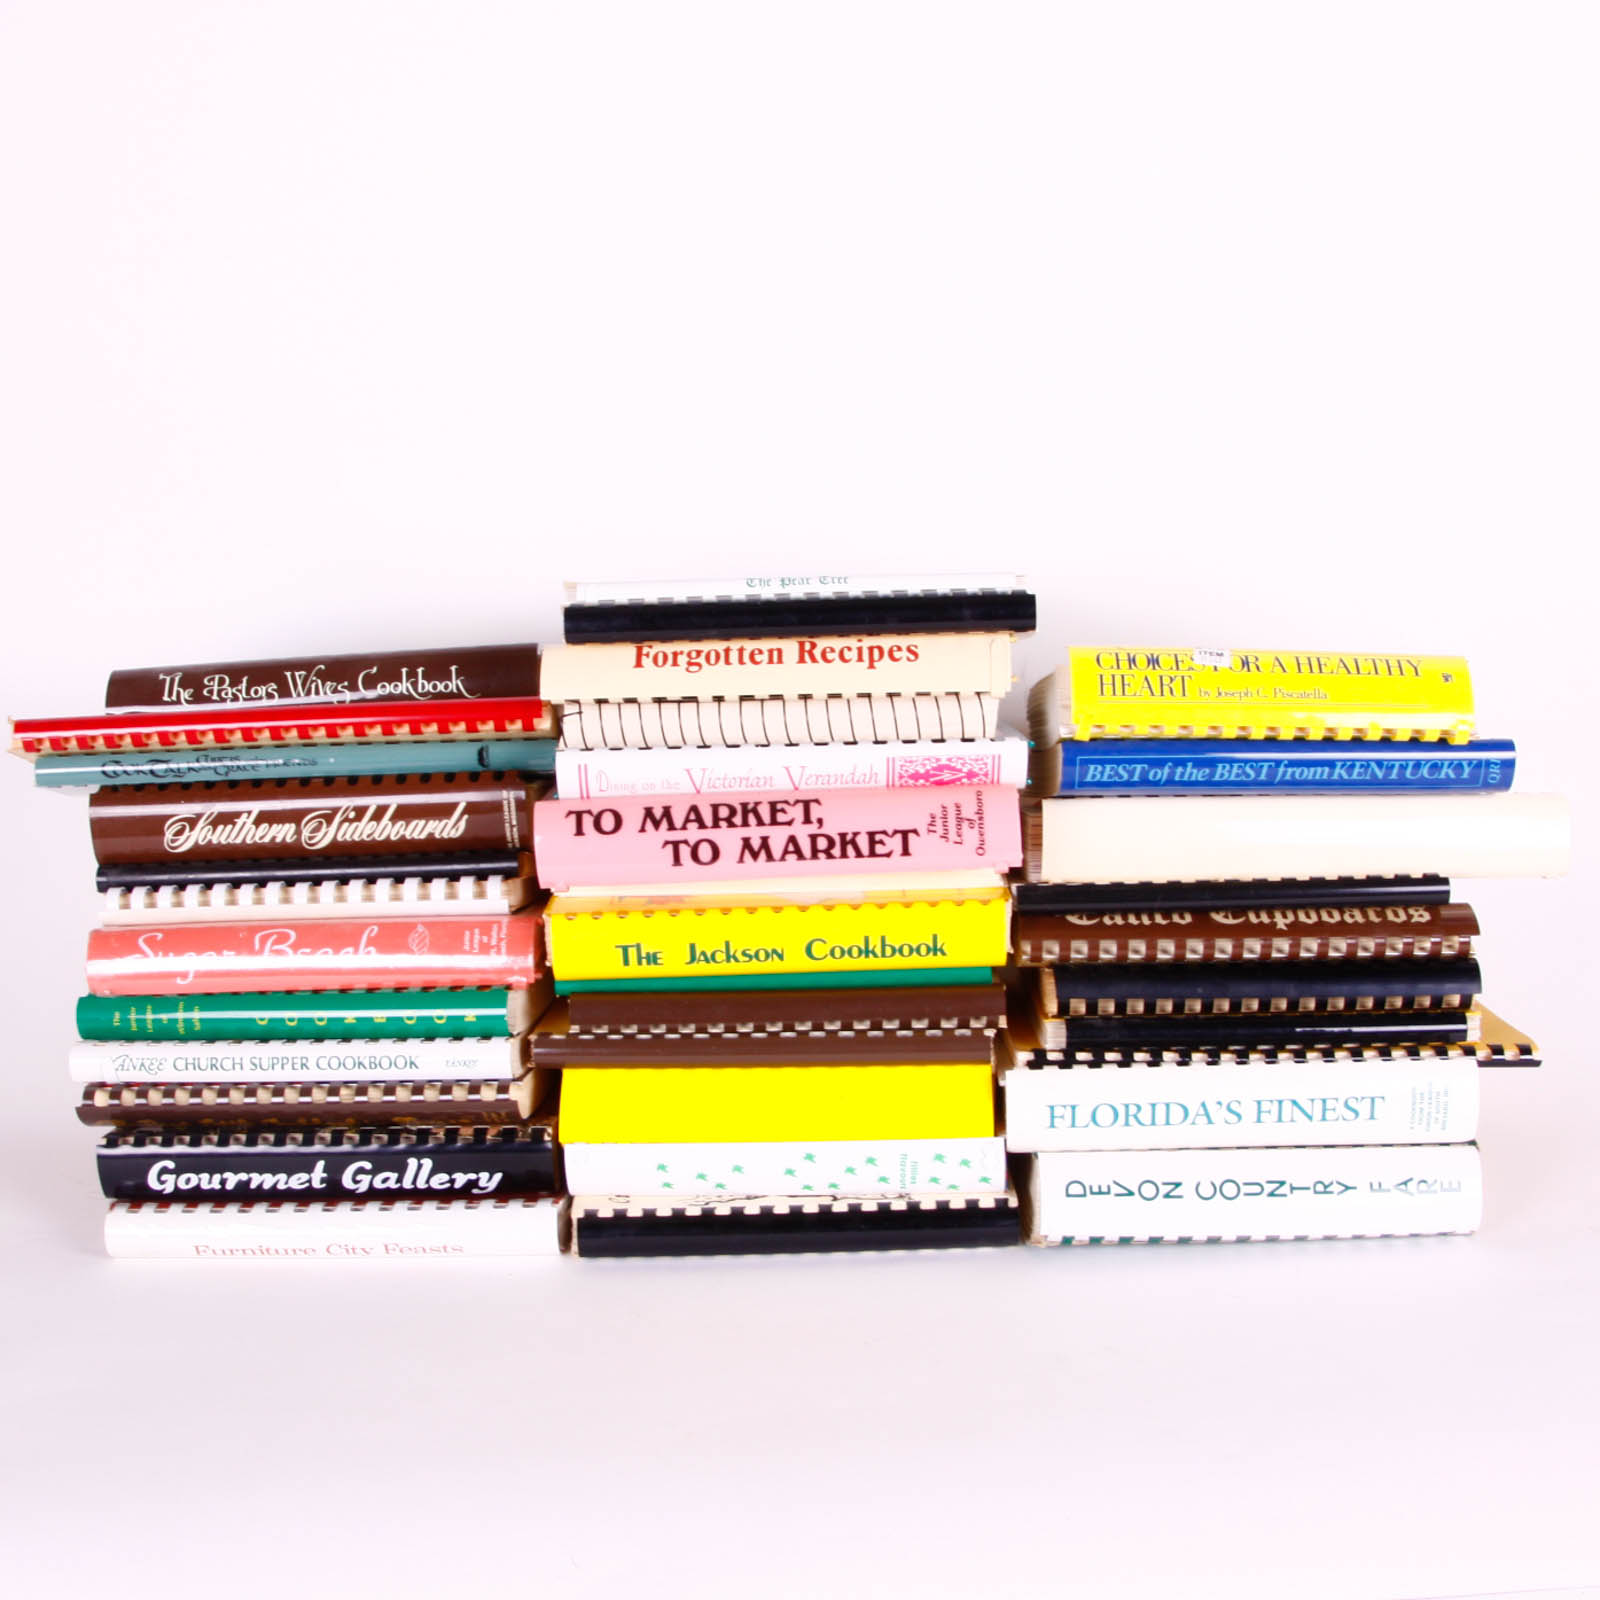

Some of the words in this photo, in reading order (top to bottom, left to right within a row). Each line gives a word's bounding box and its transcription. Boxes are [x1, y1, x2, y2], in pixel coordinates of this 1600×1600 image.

[634, 642, 784, 673] Forgotten
[796, 638, 919, 669] Recipes
[1271, 656, 1289, 673] A
[1296, 656, 1422, 678] HEALTHY
[159, 672, 195, 705] The
[202, 672, 280, 706] Pastors
[285, 664, 349, 705] Wives
[358, 663, 481, 699] Cookbook
[1096, 673, 1193, 698] HEART
[1199, 687, 1211, 698] by
[1214, 686, 1254, 701] Joseph
[1273, 687, 1328, 700] Piscatella
[596, 770, 640, 793] Dining
[642, 780, 656, 792] on
[660, 778, 681, 791] the
[684, 767, 775, 794] Victorian
[784, 764, 880, 792] Verandah
[1084, 764, 1148, 783] BEST
[1148, 762, 1173, 784] of
[1174, 763, 1210, 782] the
[1213, 762, 1275, 781] BEST
[1275, 760, 1336, 785] from
[1333, 759, 1476, 781] KENTUCKY
[164, 804, 297, 854] Southern
[300, 801, 468, 851] Sideboards
[565, 807, 623, 837] TO
[638, 799, 826, 834] MARKET,
[926, 812, 938, 835] The
[940, 804, 950, 843] Junior
[952, 802, 965, 845] League
[964, 817, 977, 830] of
[974, 790, 986, 857] Owensboro
[662, 839, 720, 867] TO
[736, 829, 920, 864] MARKET
[616, 944, 664, 967] The
[685, 940, 784, 965] Jackson
[805, 934, 947, 962] Cookbook
[112, 1054, 168, 1076] ANKEE
[172, 1056, 243, 1072] CHURCH
[249, 1055, 310, 1072] SUPPER
[315, 1054, 420, 1071] COOKBOOK
[1254, 1095, 1386, 1127] FINEST
[147, 1159, 328, 1195] Gourmet
[341, 1157, 504, 1196] Gallery
[1065, 1180, 1184, 1202] DEVON
[1195, 1178, 1358, 1201] COUNTRY
[1369, 1176, 1463, 1195] FARE
[192, 1243, 317, 1257] Furniture
[325, 1242, 375, 1257] City
[382, 1242, 465, 1256] Feasts
